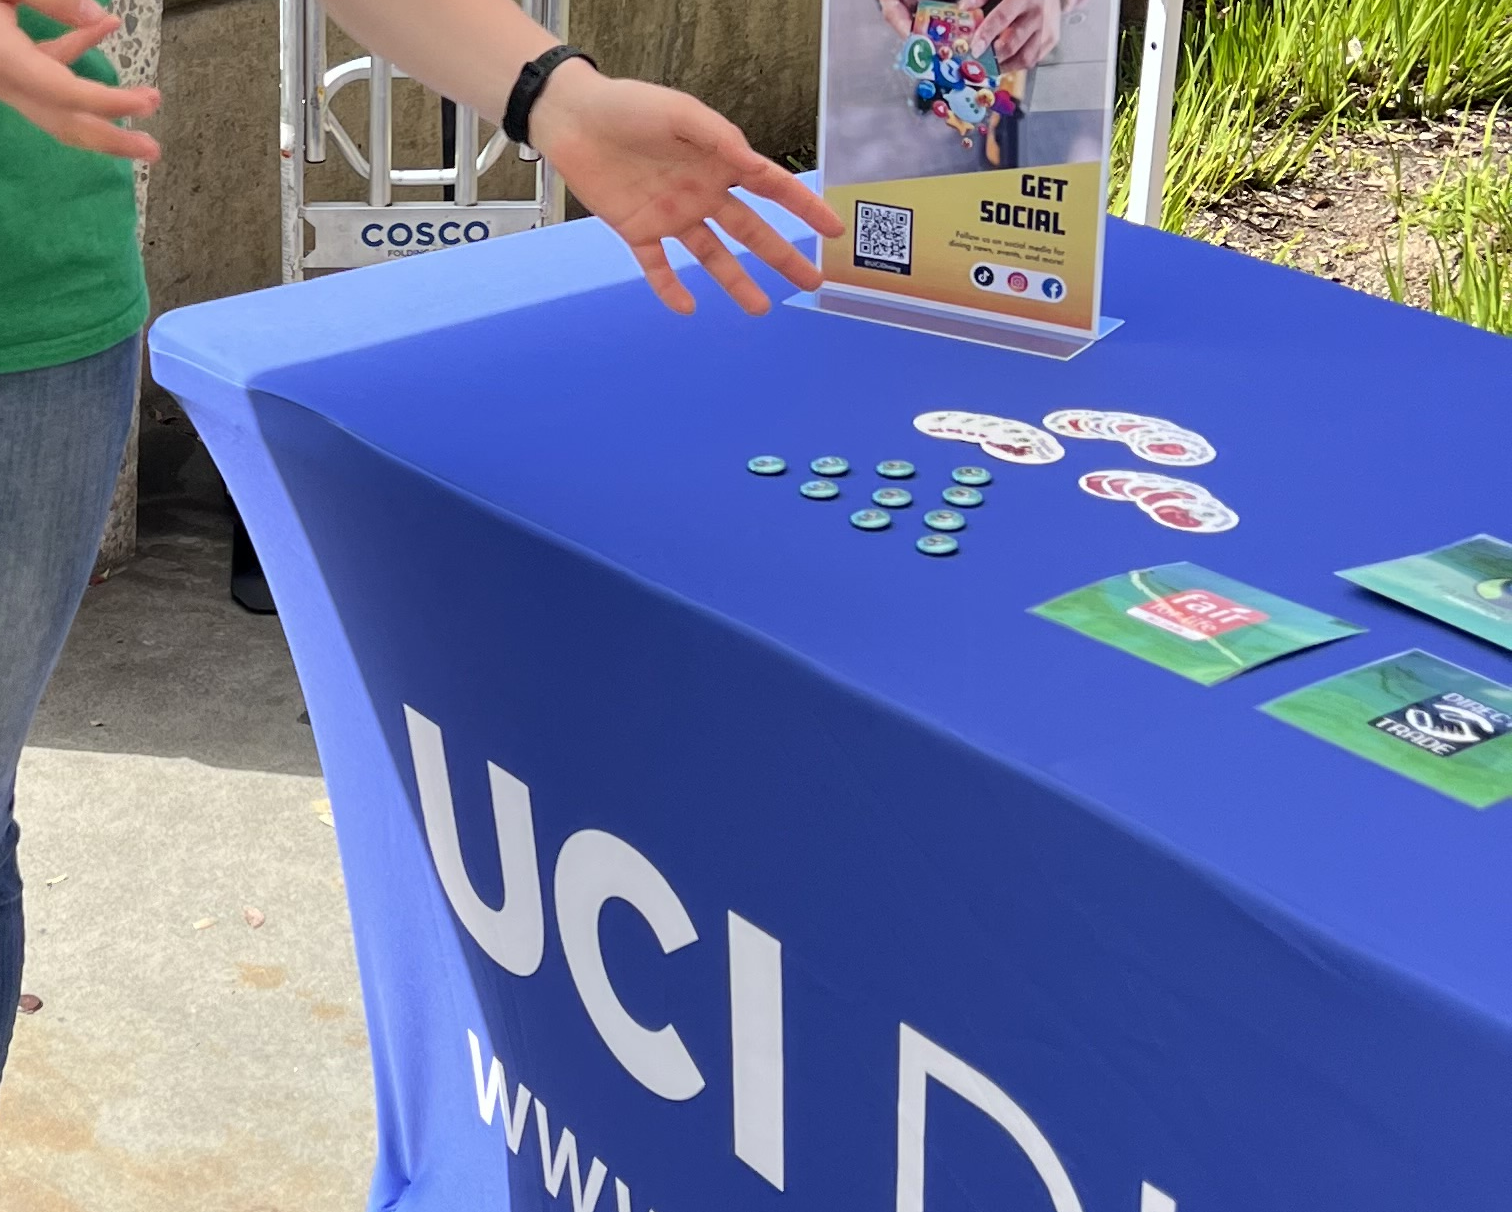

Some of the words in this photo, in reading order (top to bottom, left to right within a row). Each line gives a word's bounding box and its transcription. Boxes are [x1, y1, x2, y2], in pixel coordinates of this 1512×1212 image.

[1021, 174, 1069, 202] GET
[980, 200, 1066, 235] SOCIAL
[361, 221, 489, 247] COSCO
[1004, 240, 1026, 249] social
[1028, 244, 1052, 254] media
[1171, 592, 1253, 624] fair
[1375, 717, 1457, 755] TRADE
[403, 702, 785, 1193] UCI
